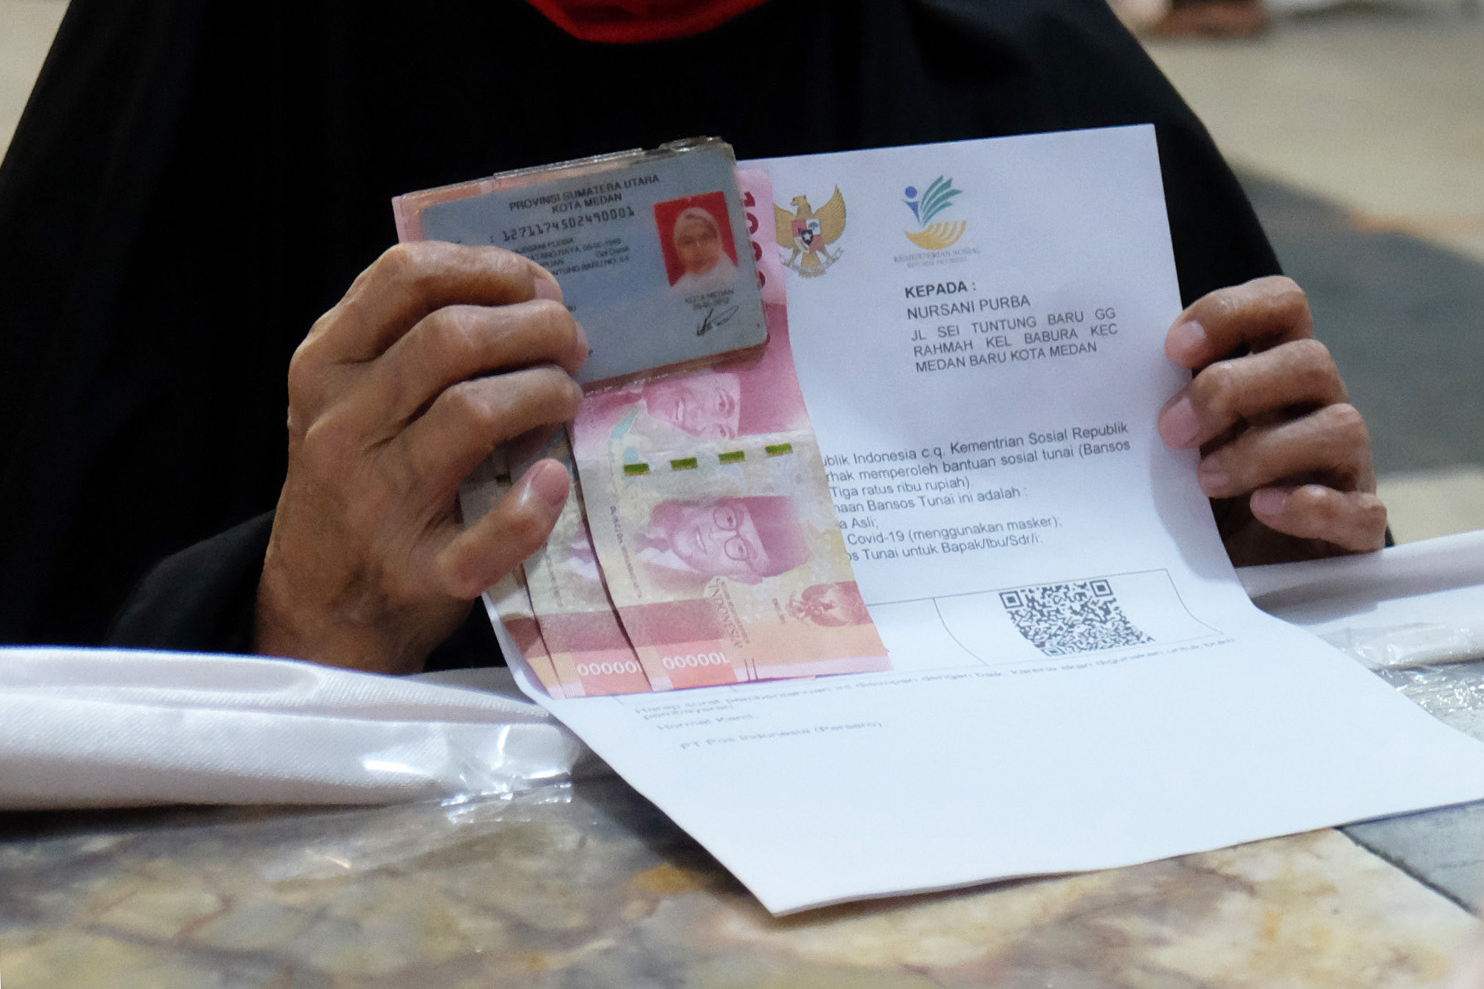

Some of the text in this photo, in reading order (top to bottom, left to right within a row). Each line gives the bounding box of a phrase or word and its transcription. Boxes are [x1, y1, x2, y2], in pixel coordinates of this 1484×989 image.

[509, 174, 660, 211] PROVINSI SUMATERA UTARA
[551, 193, 623, 214] KOTA MEDAN
[904, 280, 968, 299] KEPADA
[907, 294, 1031, 320] NURSANI PURBA
[911, 307, 1117, 342] JL SEI TUNTUNG BARU GG
[913, 323, 1119, 357] RAHMAH KEL BABURA KEC
[916, 341, 1098, 373] MEDAN BARU KOTA MEDAN
[853, 449, 917, 464] Indonesia
[950, 437, 1025, 455] Kementrian
[1028, 428, 1068, 445] Sosial
[1072, 421, 1129, 440] Republik
[859, 464, 938, 481] memperoleh
[943, 457, 996, 473] bantuan
[1000, 450, 1038, 466] sosial
[1042, 445, 1074, 459] tunai
[1078, 440, 1131, 459] (Bansos
[829, 486, 859, 500] Tiga
[862, 484, 895, 496] ratus
[897, 481, 922, 493] ribu
[867, 498, 915, 511] Bansos
[918, 494, 955, 507] Tunai
[959, 492, 973, 503] ini
[977, 486, 1021, 502] adalah
[847, 530, 905, 545] Covid-19
[908, 522, 1004, 543] (menggunakan
[862, 548, 899, 561] Tunai
[902, 543, 941, 556] untuk
